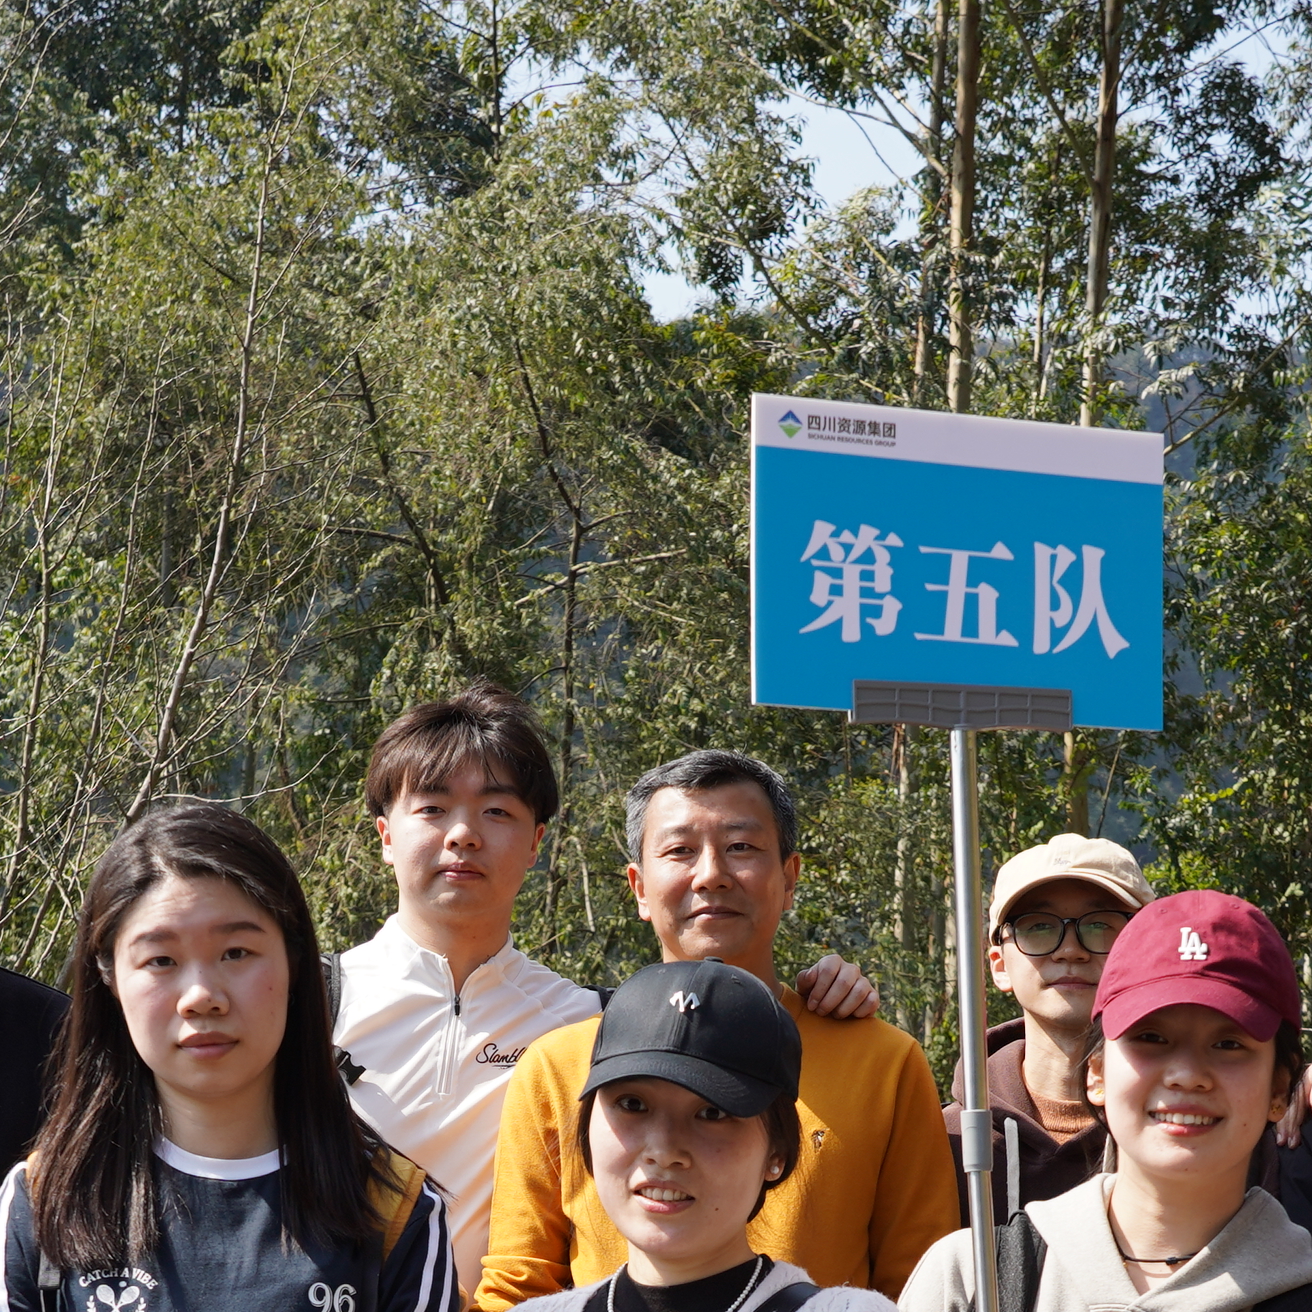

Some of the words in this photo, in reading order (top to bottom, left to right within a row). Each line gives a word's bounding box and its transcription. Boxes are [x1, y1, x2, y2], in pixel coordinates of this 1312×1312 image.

[807, 414, 896, 439] 四川资源集团
[807, 432, 836, 442] SICHUAN
[837, 436, 873, 446] RESOURCES
[874, 439, 896, 447] GROUP
[798, 519, 1130, 660] 第五队
[1177, 926, 1208, 960] LA
[78, 1268, 119, 1288] CATCH
[120, 1267, 130, 1278] A
[132, 1267, 159, 1290] VIBE
